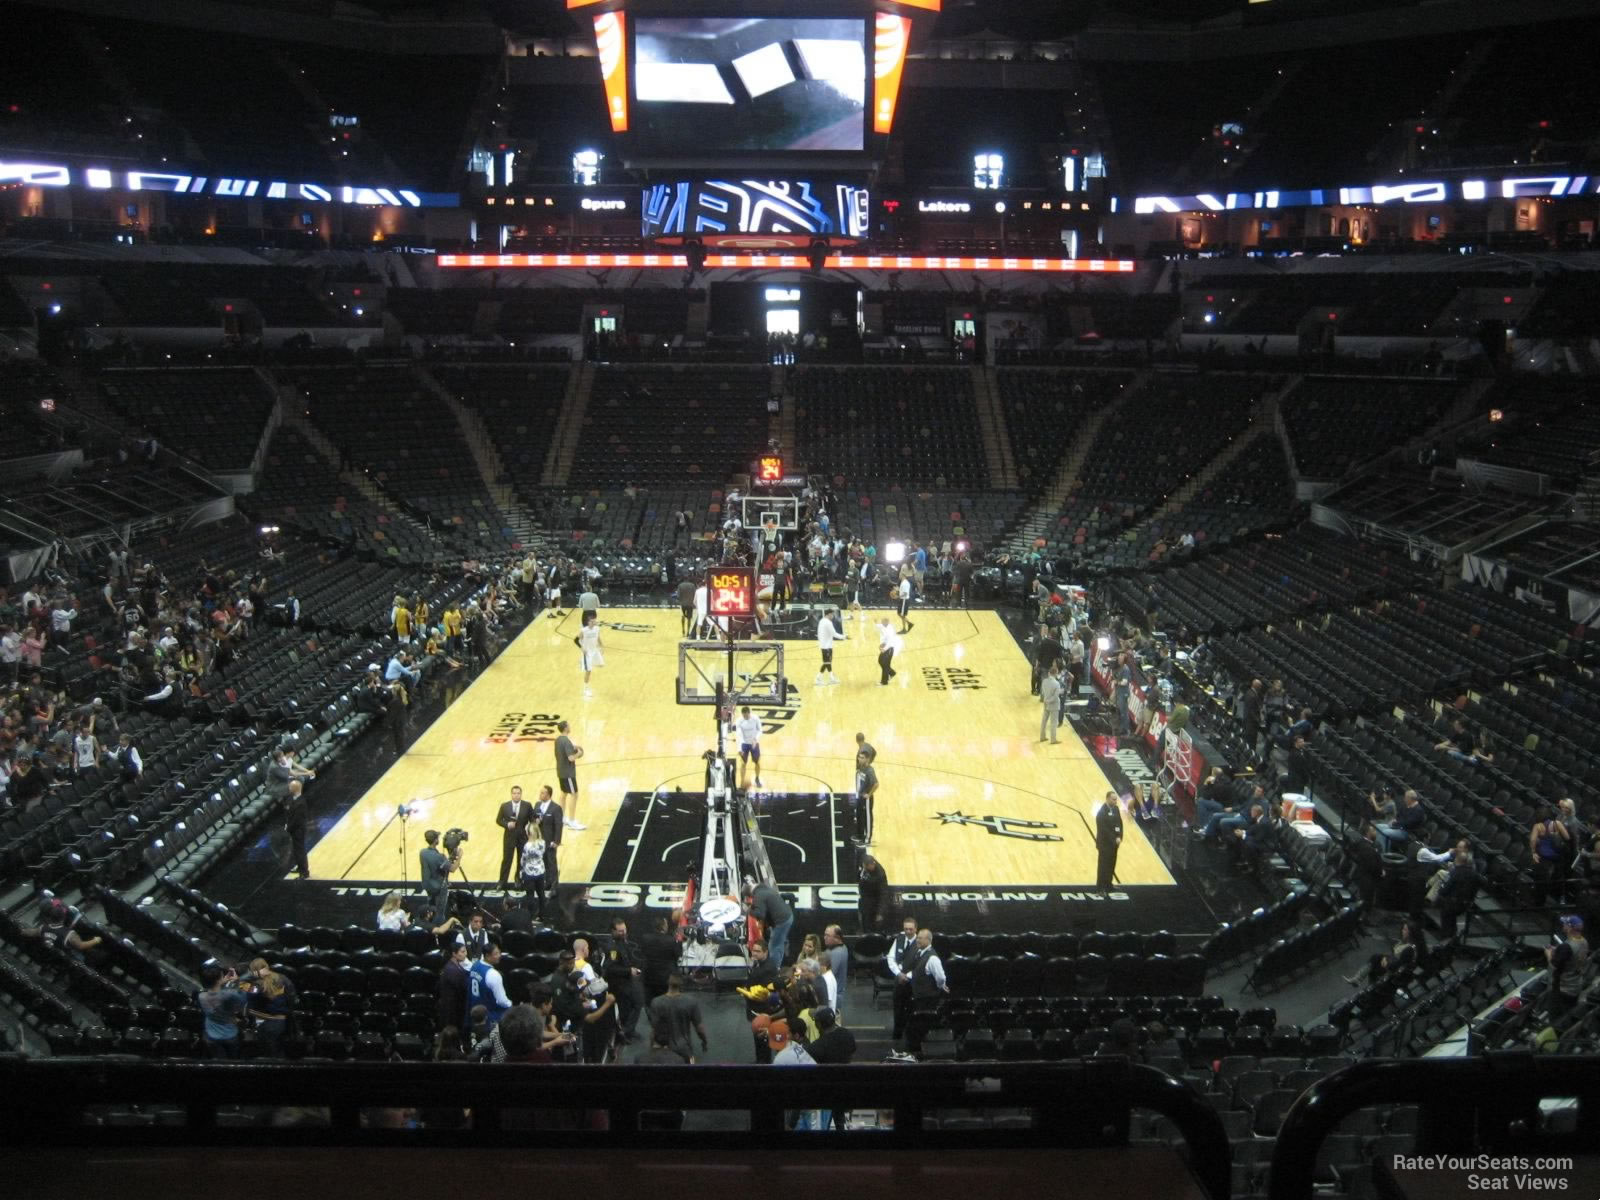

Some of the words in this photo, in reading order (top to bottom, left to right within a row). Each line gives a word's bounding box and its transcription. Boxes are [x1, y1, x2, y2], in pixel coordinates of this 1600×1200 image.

[581, 198, 626, 210] Spurs
[919, 201, 971, 212] Lakers
[763, 466, 779, 478] 24
[715, 588, 745, 611] 24
[587, 884, 860, 910] SPRS
[901, 892, 1049, 901] ANTONIO
[1060, 892, 1130, 901] SAN
[471, 978, 480, 997] 8
